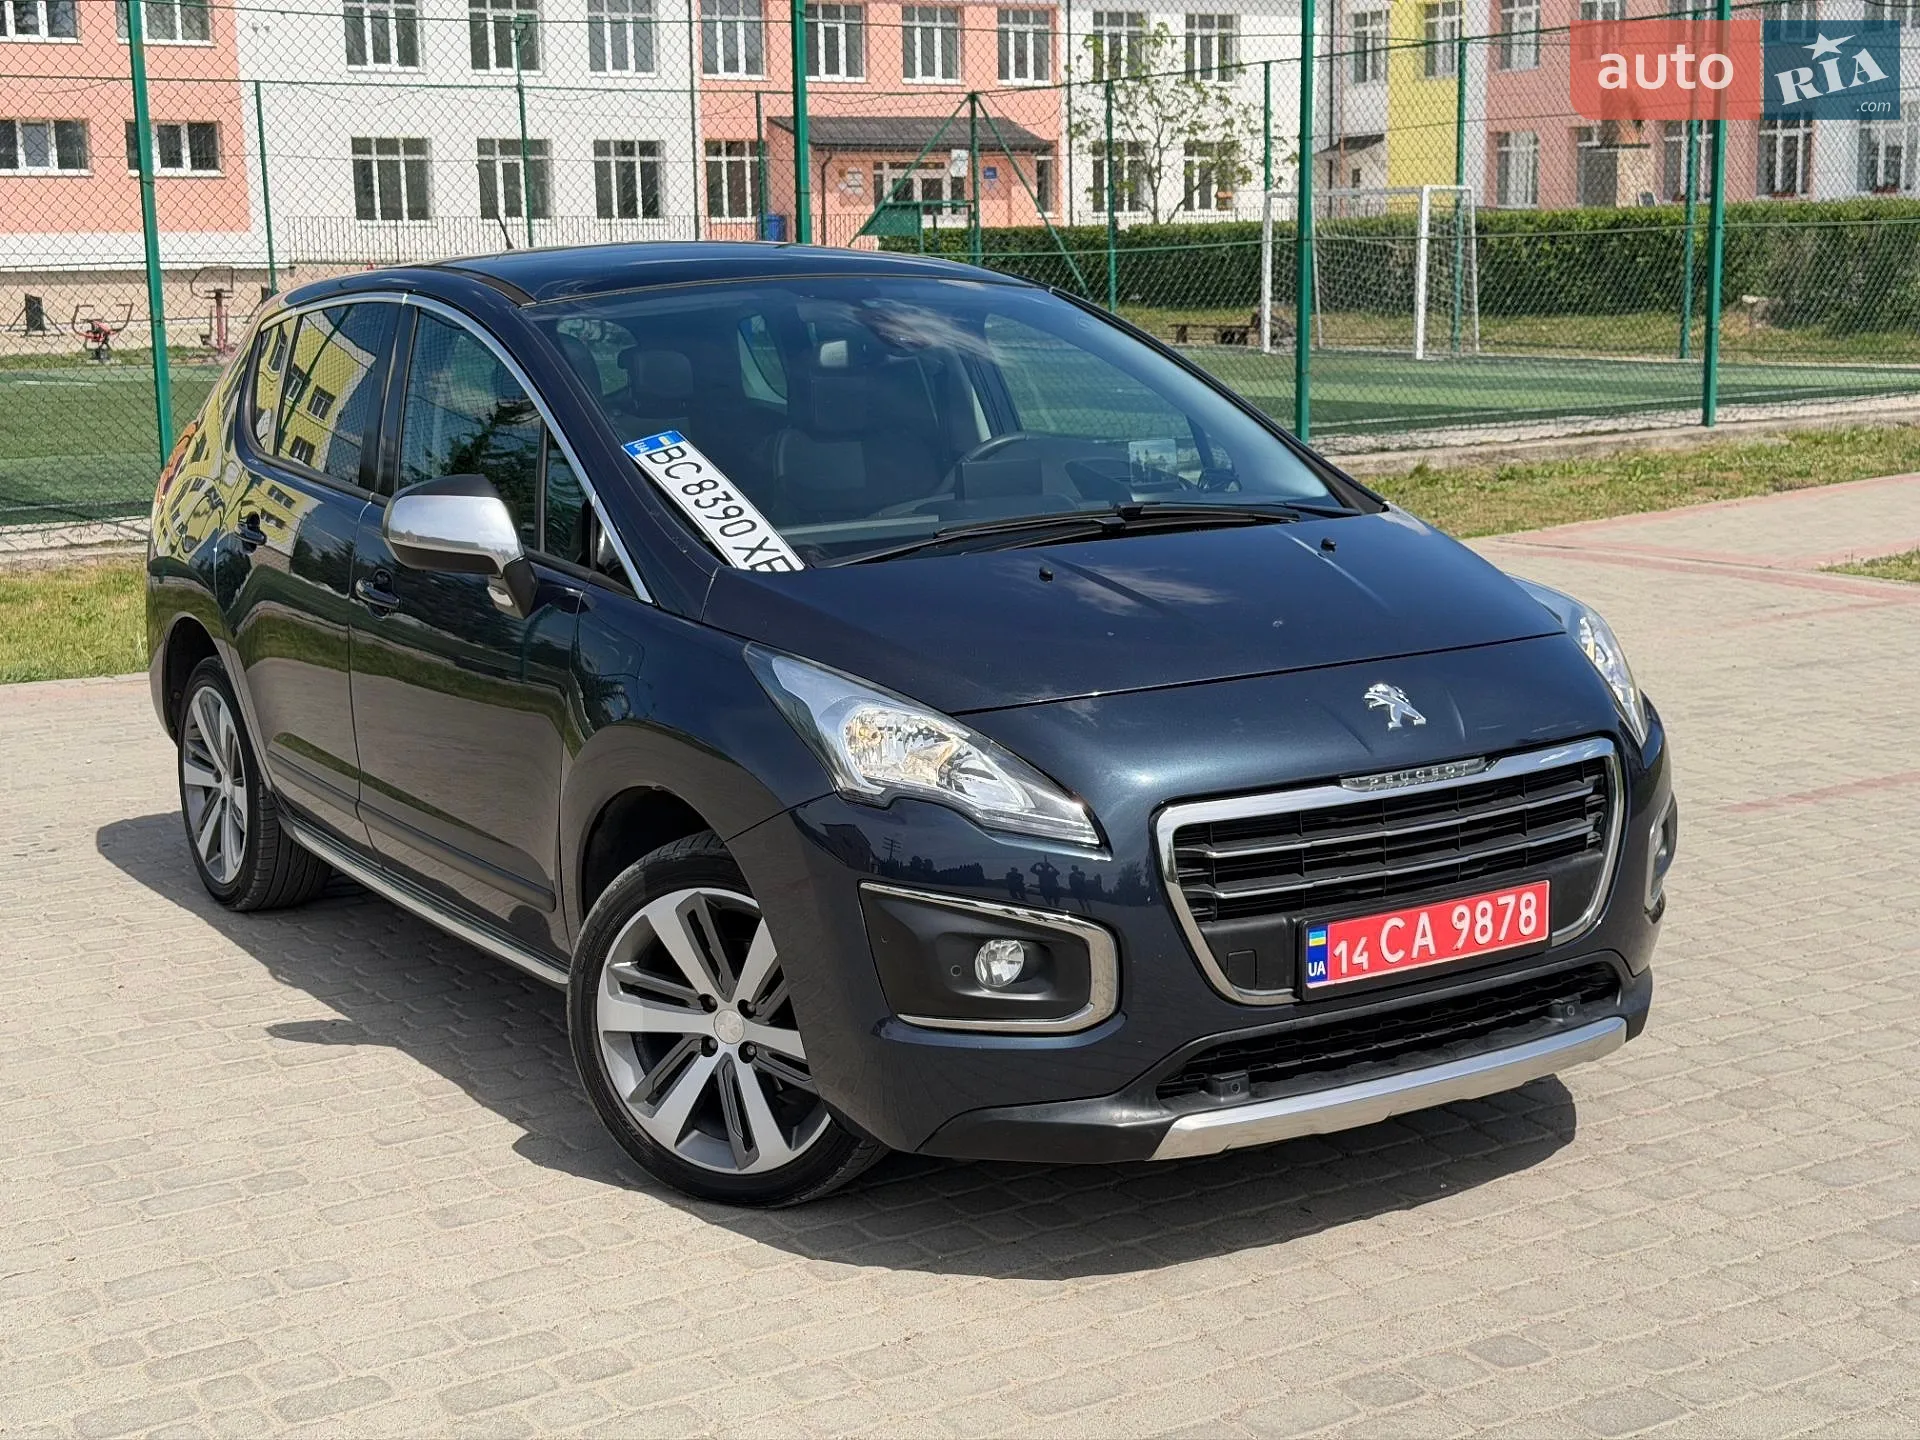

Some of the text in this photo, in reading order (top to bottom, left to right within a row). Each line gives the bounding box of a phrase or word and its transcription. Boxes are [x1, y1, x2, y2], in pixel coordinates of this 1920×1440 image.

[645, 445, 703, 479] BC
[681, 479, 757, 537] 8390
[1369, 763, 1468, 786] PEUGEOT
[1333, 891, 1537, 975] 14 CA 9878
[1307, 961, 1326, 976] UA
